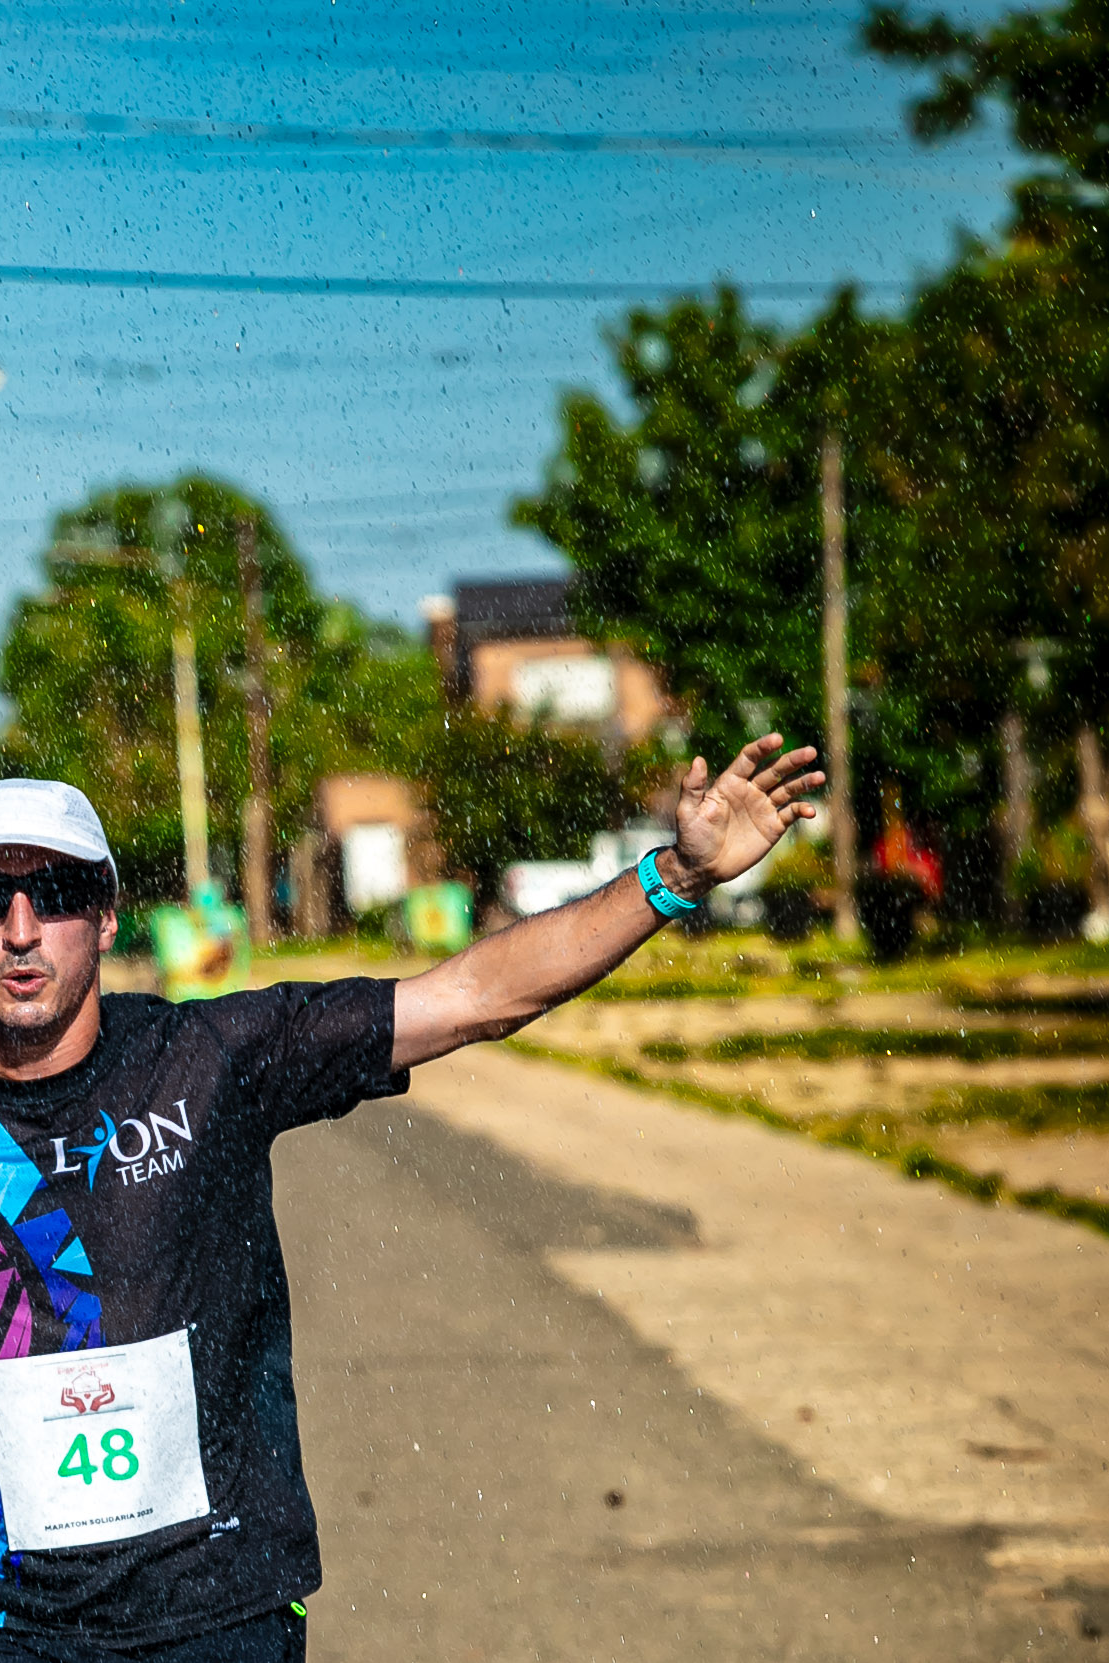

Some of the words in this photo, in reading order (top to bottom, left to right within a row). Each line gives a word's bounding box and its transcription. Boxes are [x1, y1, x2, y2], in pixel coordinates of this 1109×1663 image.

[116, 1149, 184, 1186] TEAM
[57, 1428, 140, 1486] 48
[44, 1520, 88, 1532] MARATON
[89, 1512, 136, 1526] SOLIDARIA
[137, 1507, 154, 1518] 2025
